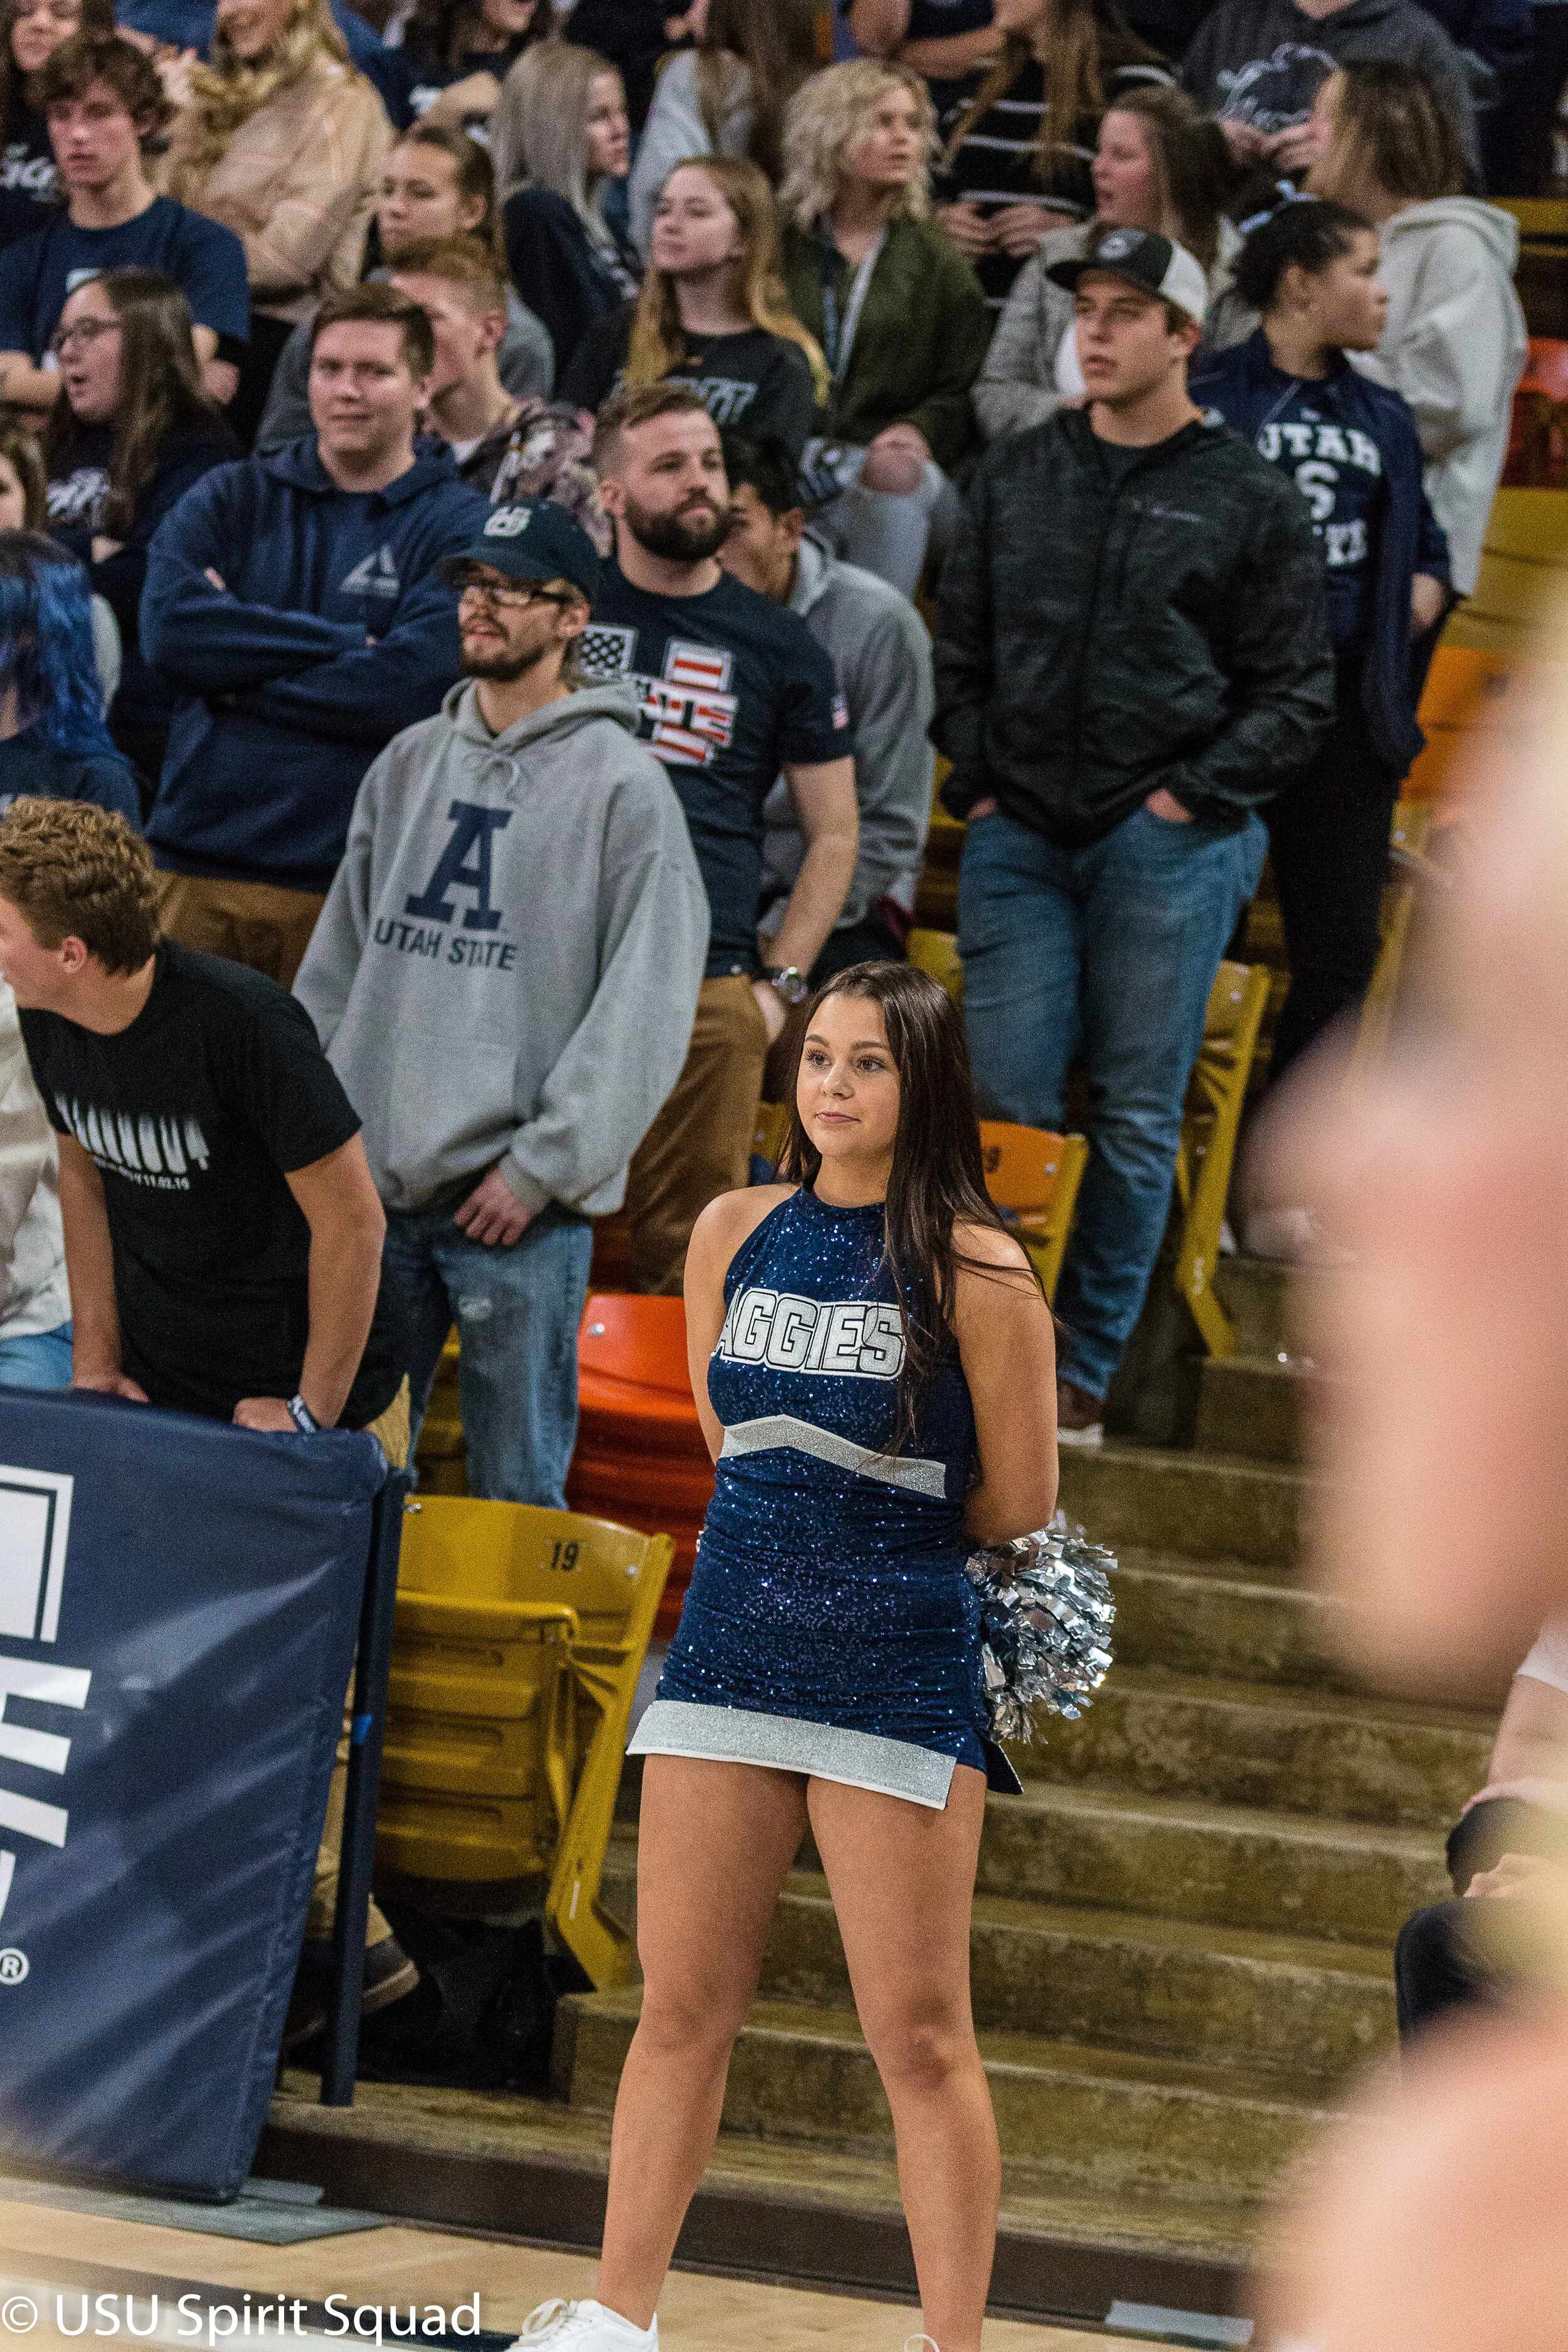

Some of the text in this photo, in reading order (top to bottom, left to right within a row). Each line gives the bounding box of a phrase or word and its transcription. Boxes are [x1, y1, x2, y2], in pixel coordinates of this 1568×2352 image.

[405, 798, 514, 931] A
[374, 918, 517, 971] UTAH STATE
[710, 1283, 906, 1380] AGGIES
[551, 1541, 580, 1572] 19
